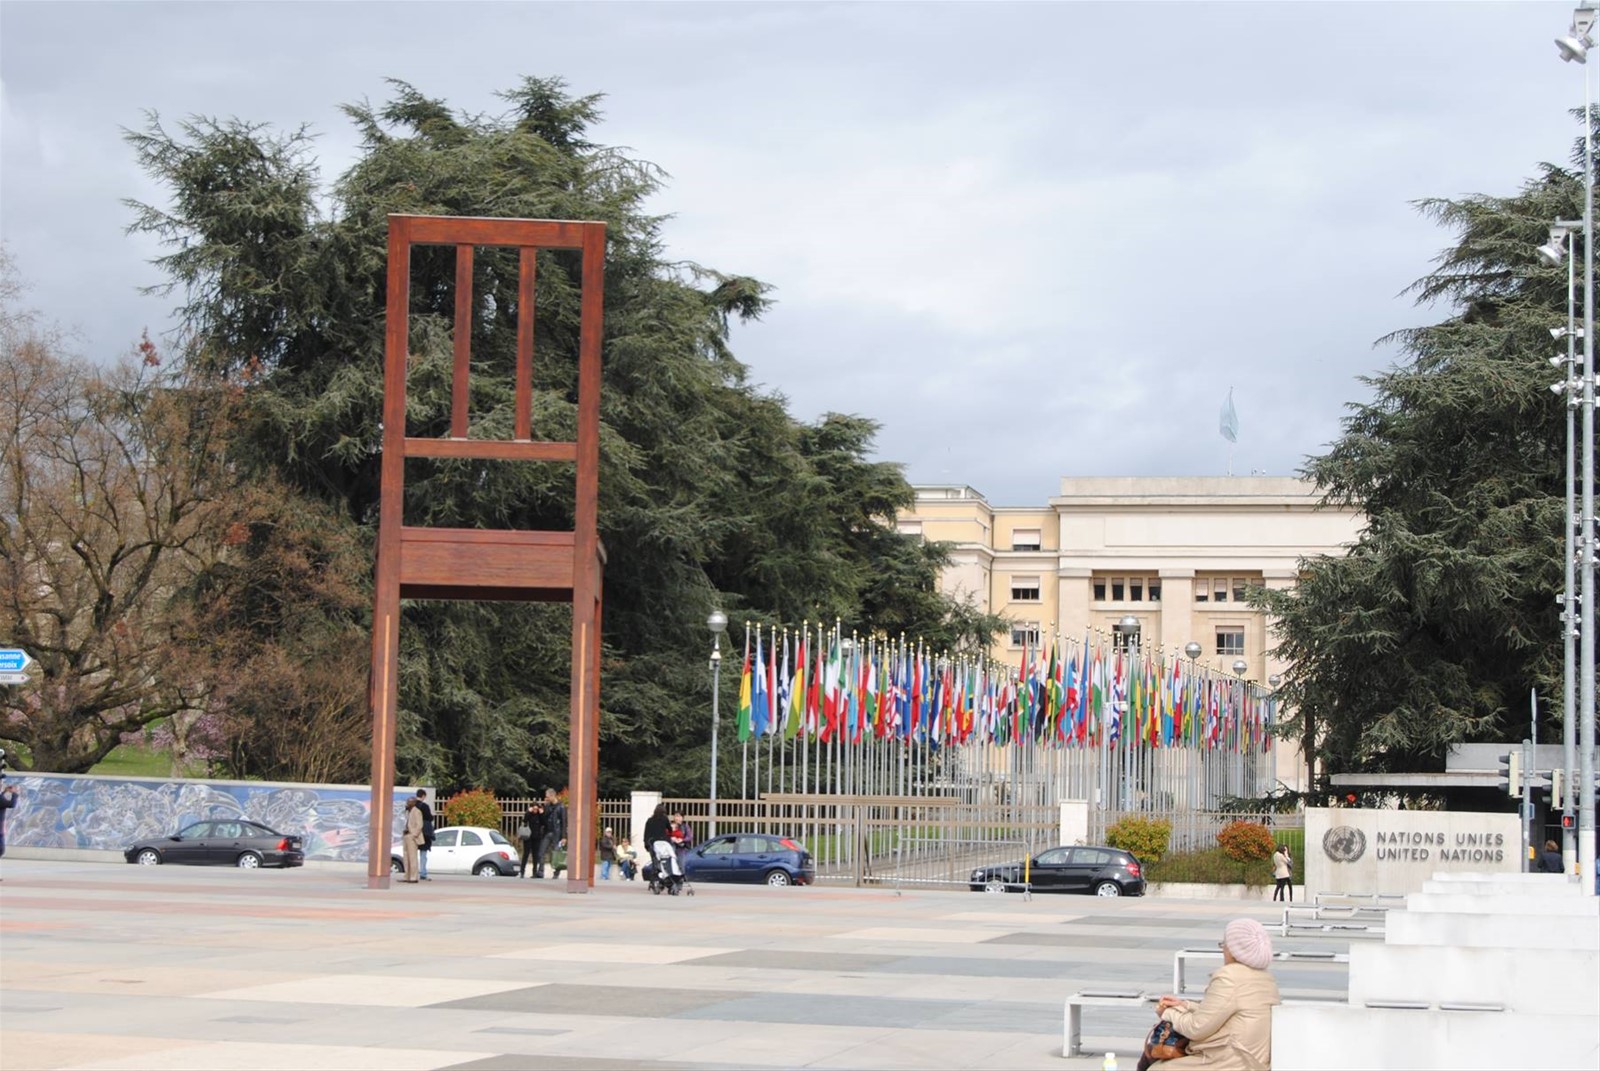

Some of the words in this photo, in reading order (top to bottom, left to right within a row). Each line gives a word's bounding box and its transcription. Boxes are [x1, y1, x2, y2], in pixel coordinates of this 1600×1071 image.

[1377, 832, 1445, 845] NATIONS
[1456, 833, 1504, 846] UNIES
[1377, 848, 1429, 861] UNITED
[1440, 849, 1504, 862] NATIONS
